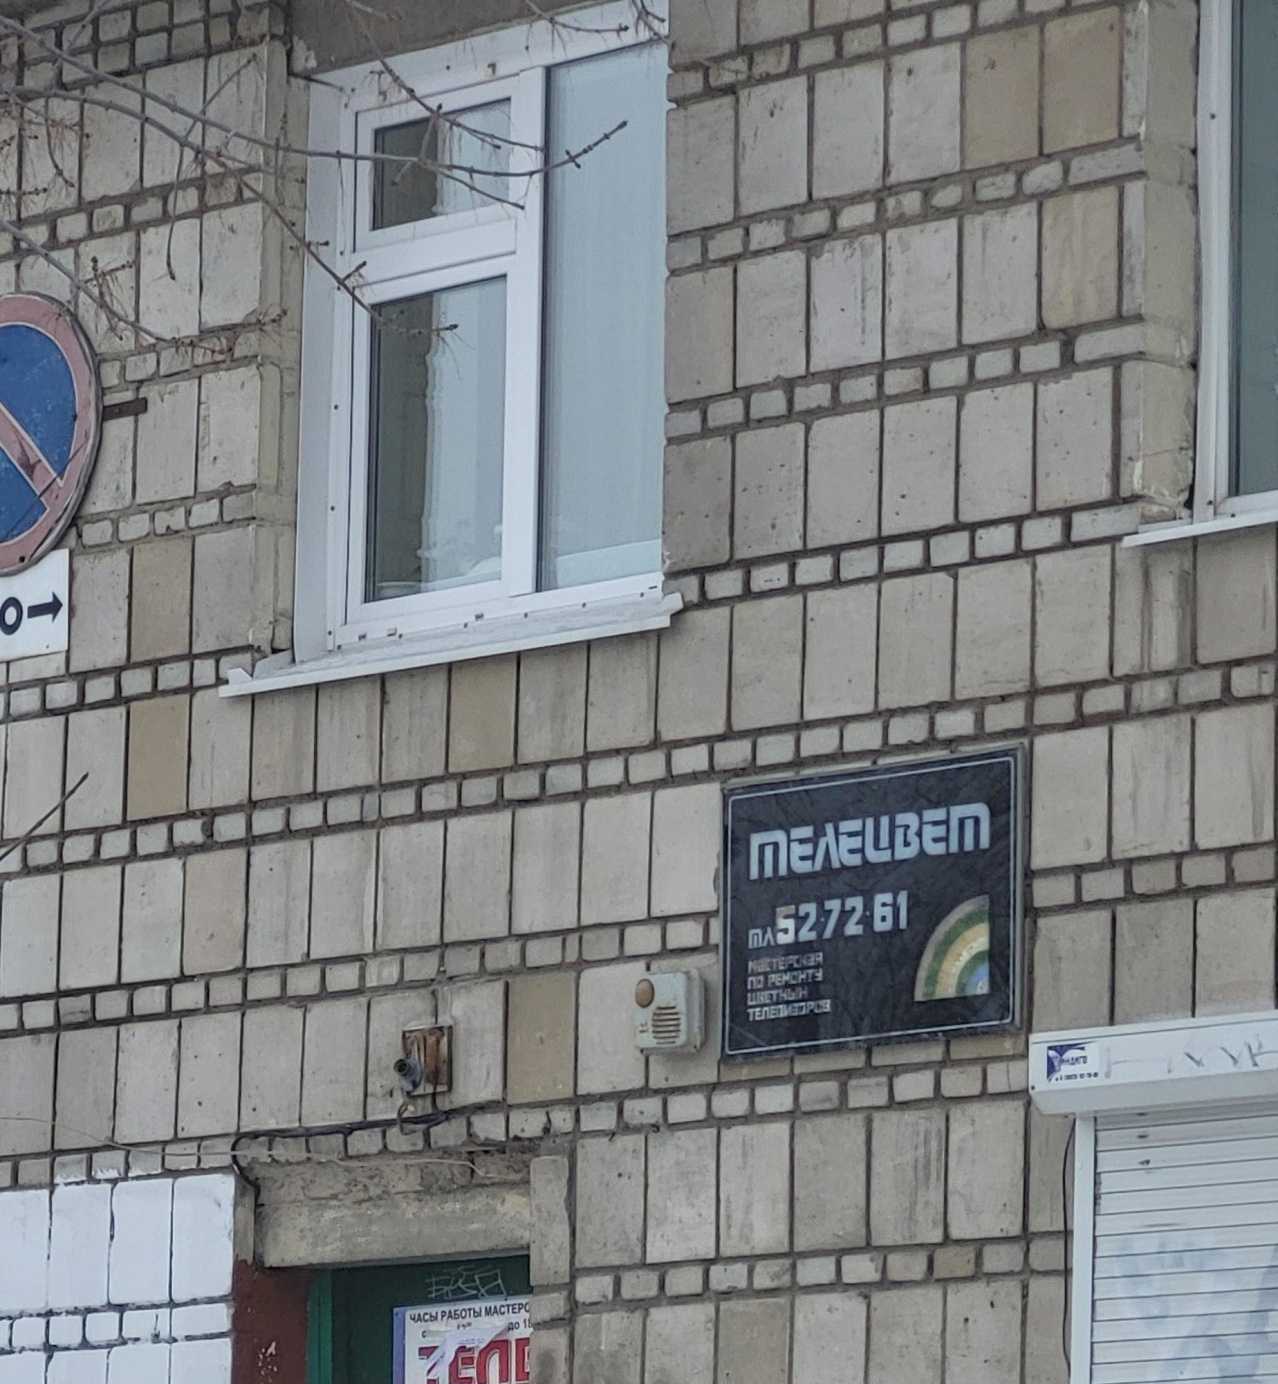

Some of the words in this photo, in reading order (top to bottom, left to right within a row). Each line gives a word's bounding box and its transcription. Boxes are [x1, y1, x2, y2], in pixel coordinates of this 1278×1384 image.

[748, 951, 823, 974] МАСТЕРСКАЯ
[747, 975, 764, 990] ПО
[768, 967, 823, 987] РЕМОНТУ
[746, 999, 832, 1021] ТЕЛЕВИЗОРОВ
[409, 1312, 438, 1323] ЧАСЫ
[440, 1307, 482, 1321] РАБОТЫ
[508, 1321, 520, 1332] до
